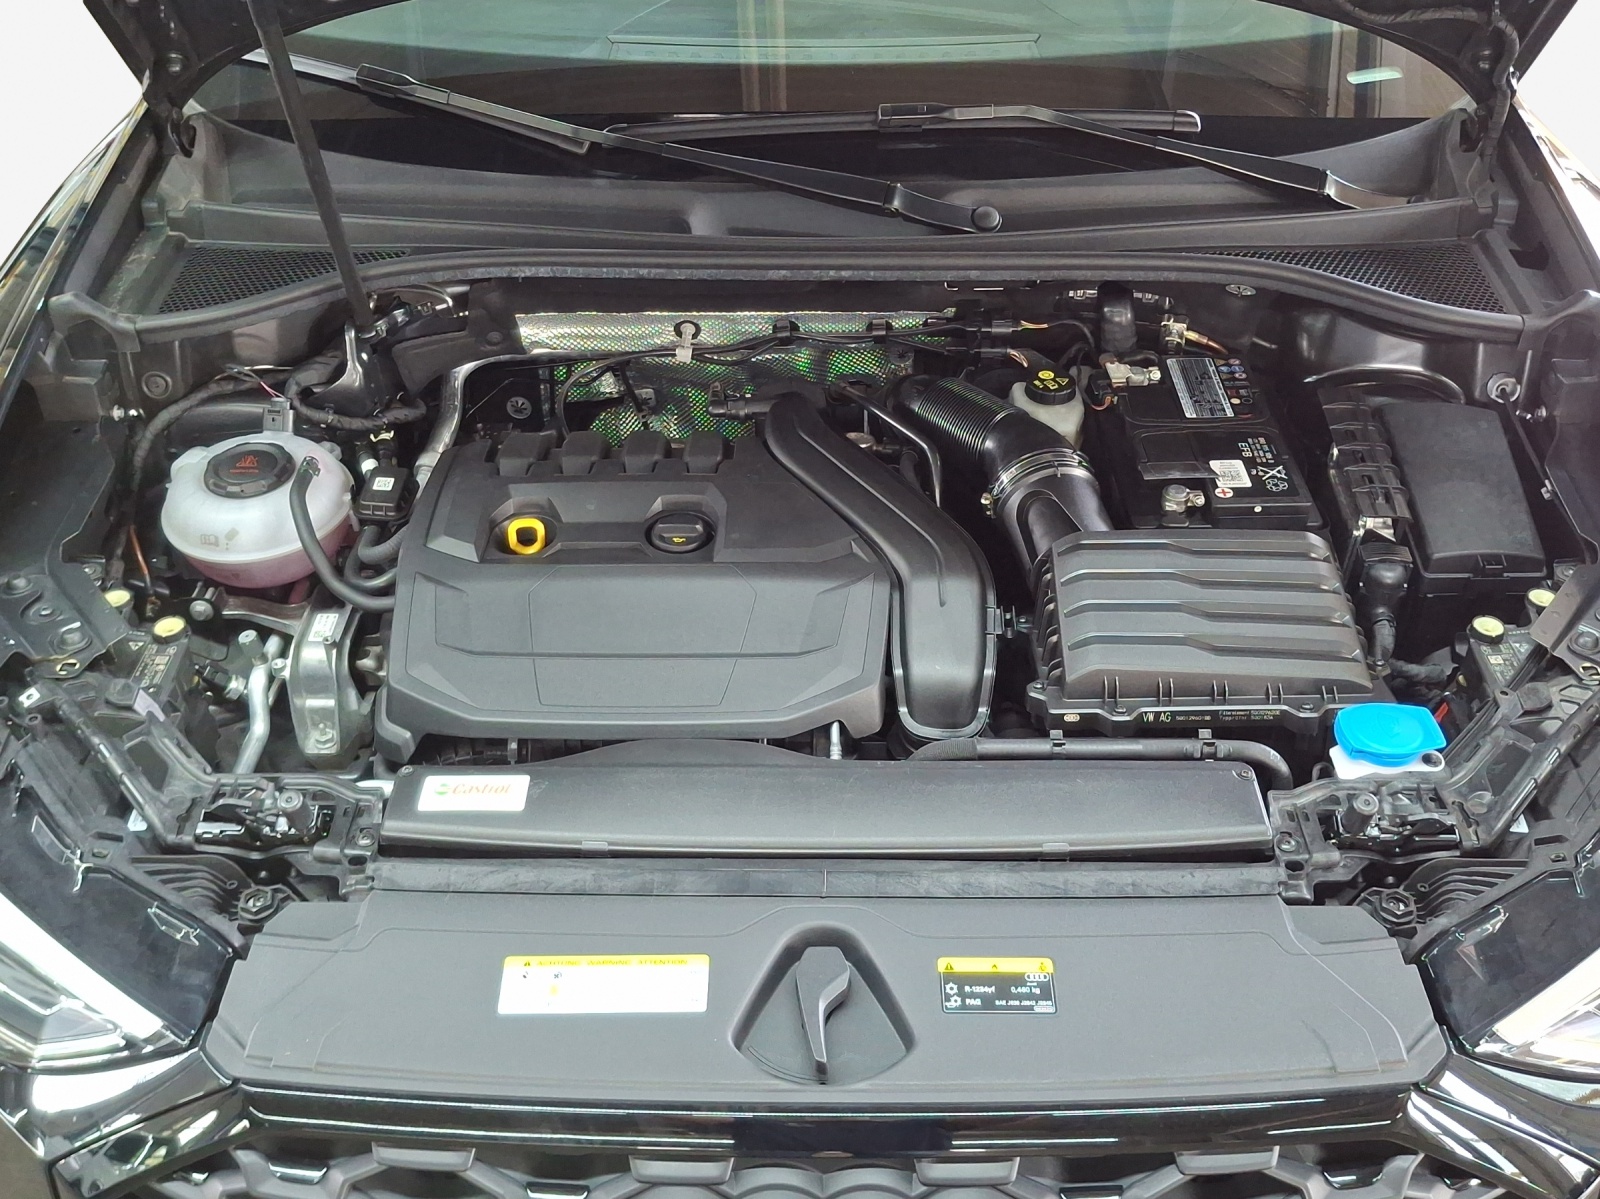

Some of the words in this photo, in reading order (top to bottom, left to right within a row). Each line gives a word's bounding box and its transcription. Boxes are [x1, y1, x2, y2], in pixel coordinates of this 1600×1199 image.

[1238, 442, 1253, 458] EFB
[1142, 712, 1155, 722] VW
[1159, 712, 1172, 722] AG
[452, 783, 512, 795] Castrol
[964, 985, 996, 994] R-1234yf
[1031, 986, 1041, 995] kg
[965, 998, 982, 1006] PAG
